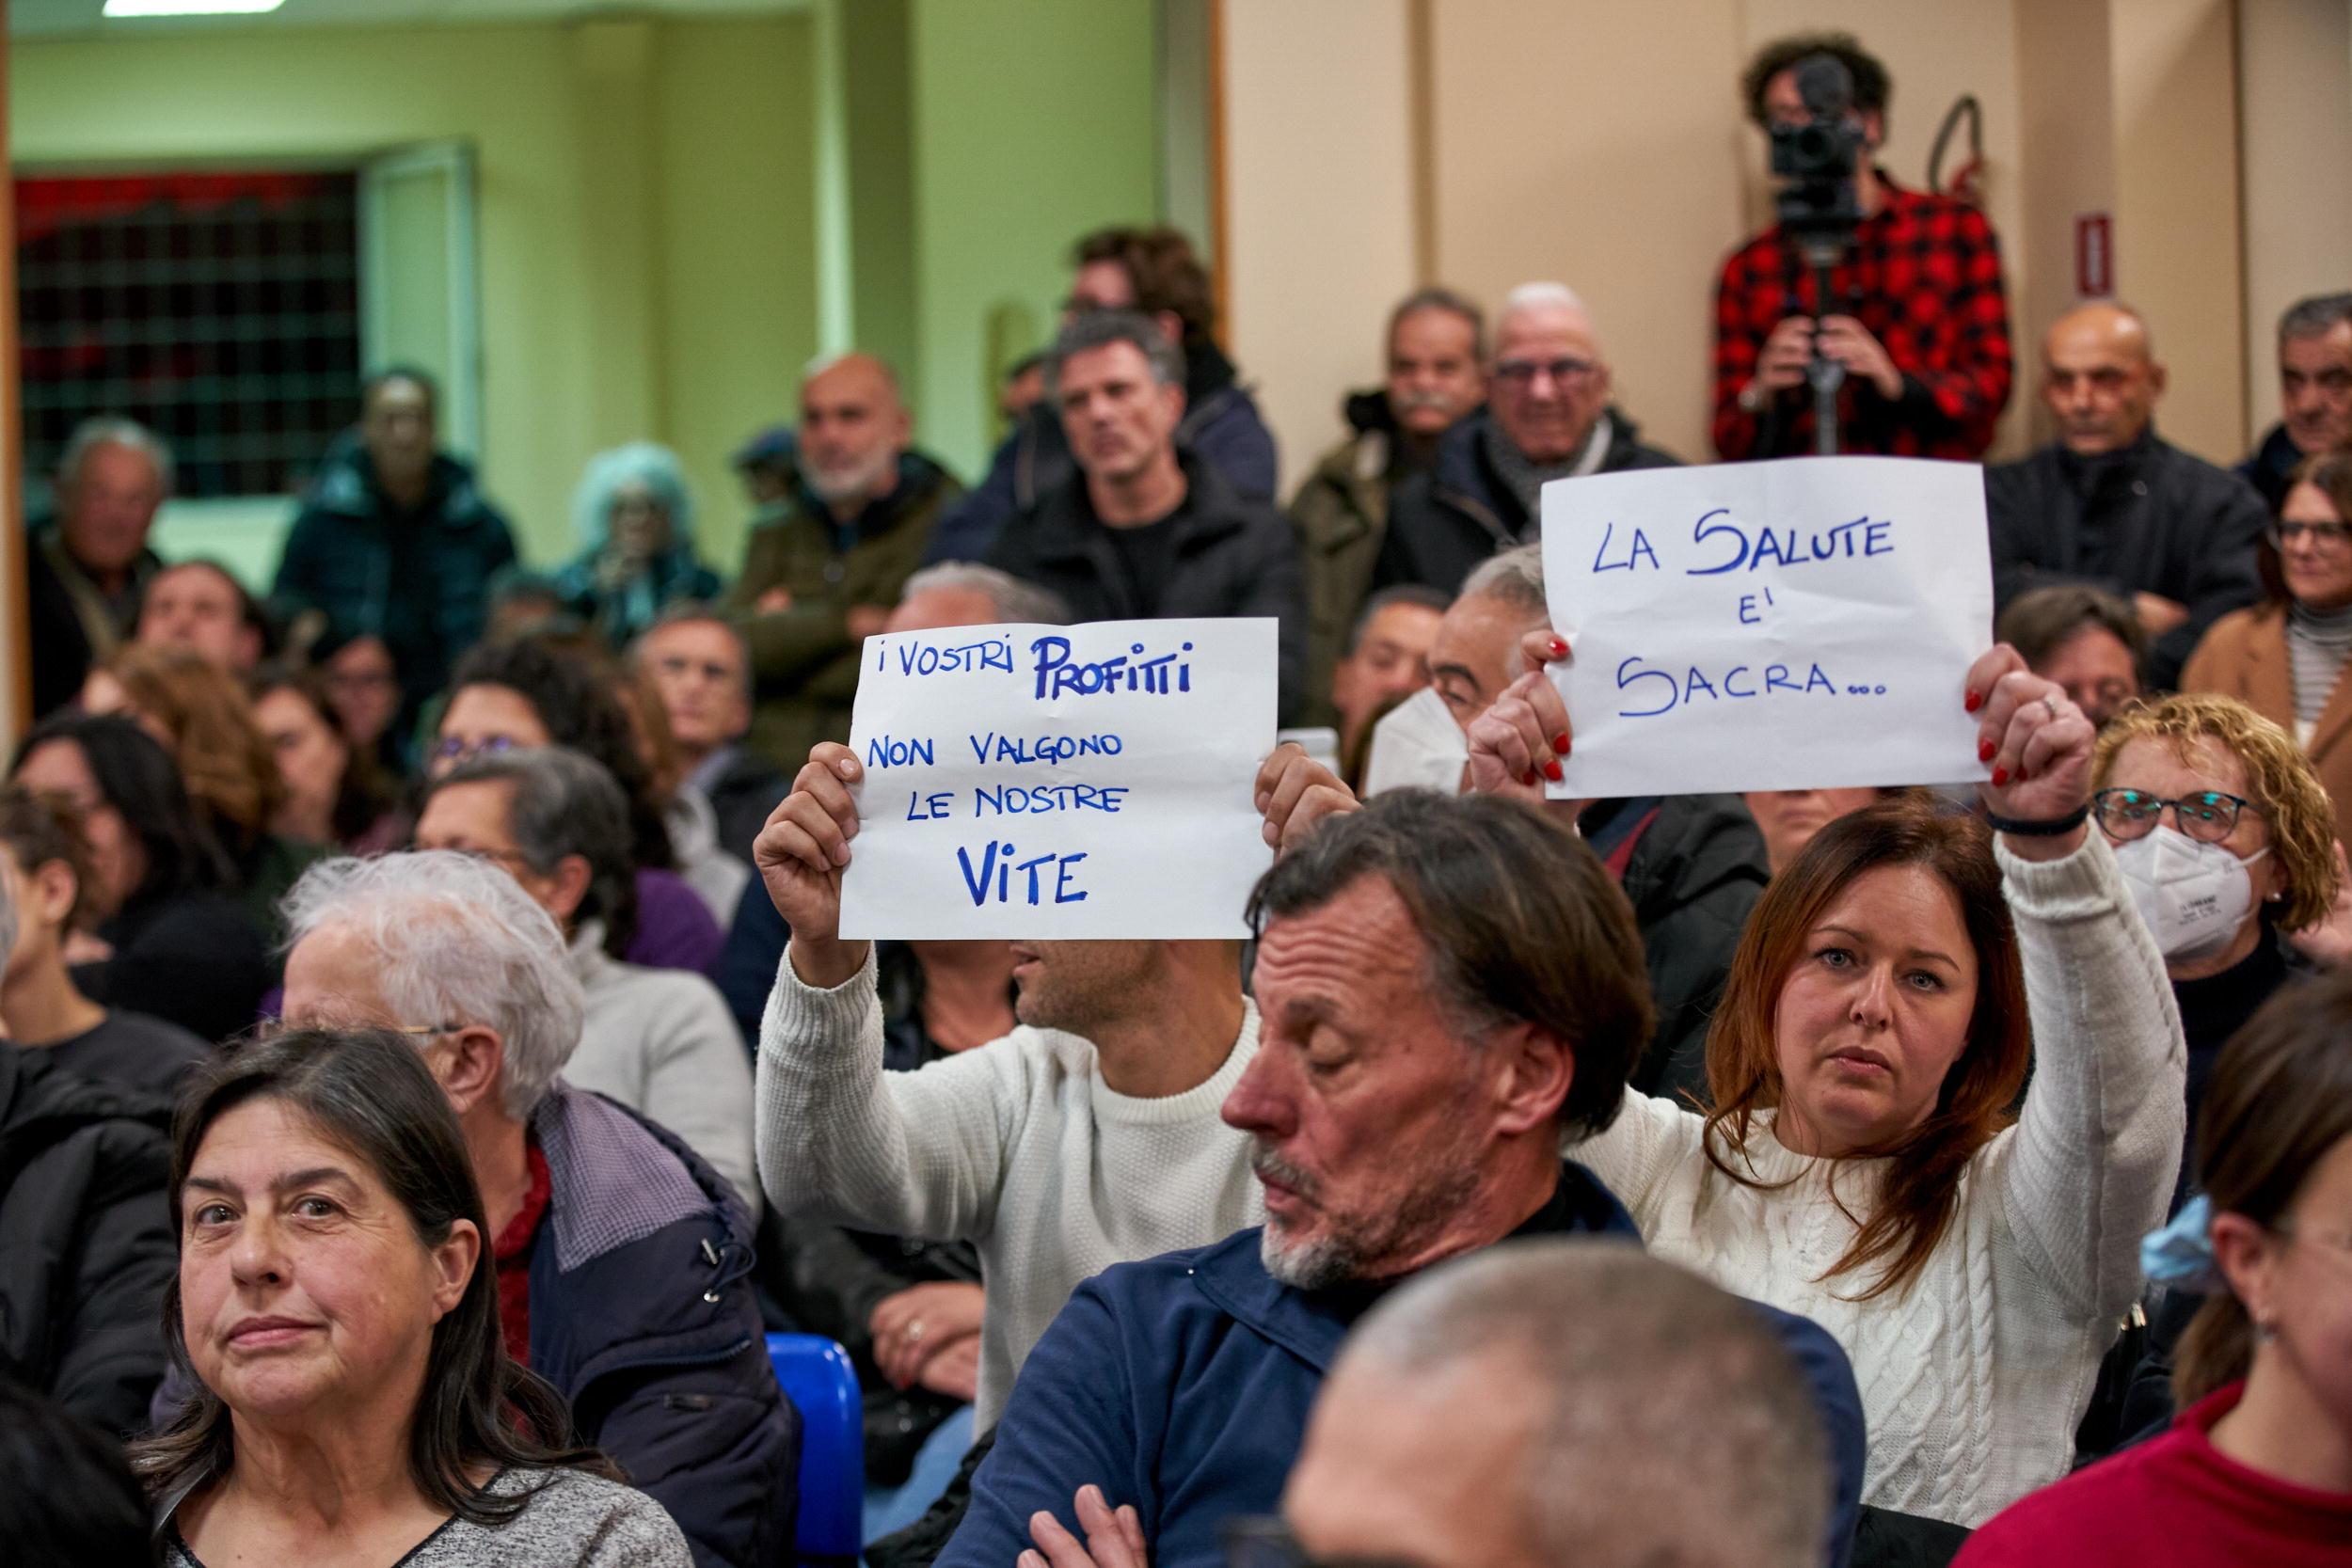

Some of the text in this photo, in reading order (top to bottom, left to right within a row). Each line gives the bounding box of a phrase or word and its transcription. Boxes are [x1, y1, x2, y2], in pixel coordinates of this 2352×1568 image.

[1593, 508, 1894, 576] LA SALUTE
[1738, 586, 1774, 625] E'
[1615, 657, 1887, 719] SACRA...
[867, 732, 1123, 768] NON VALGONO
[906, 784, 1130, 822] LE NOSTRE
